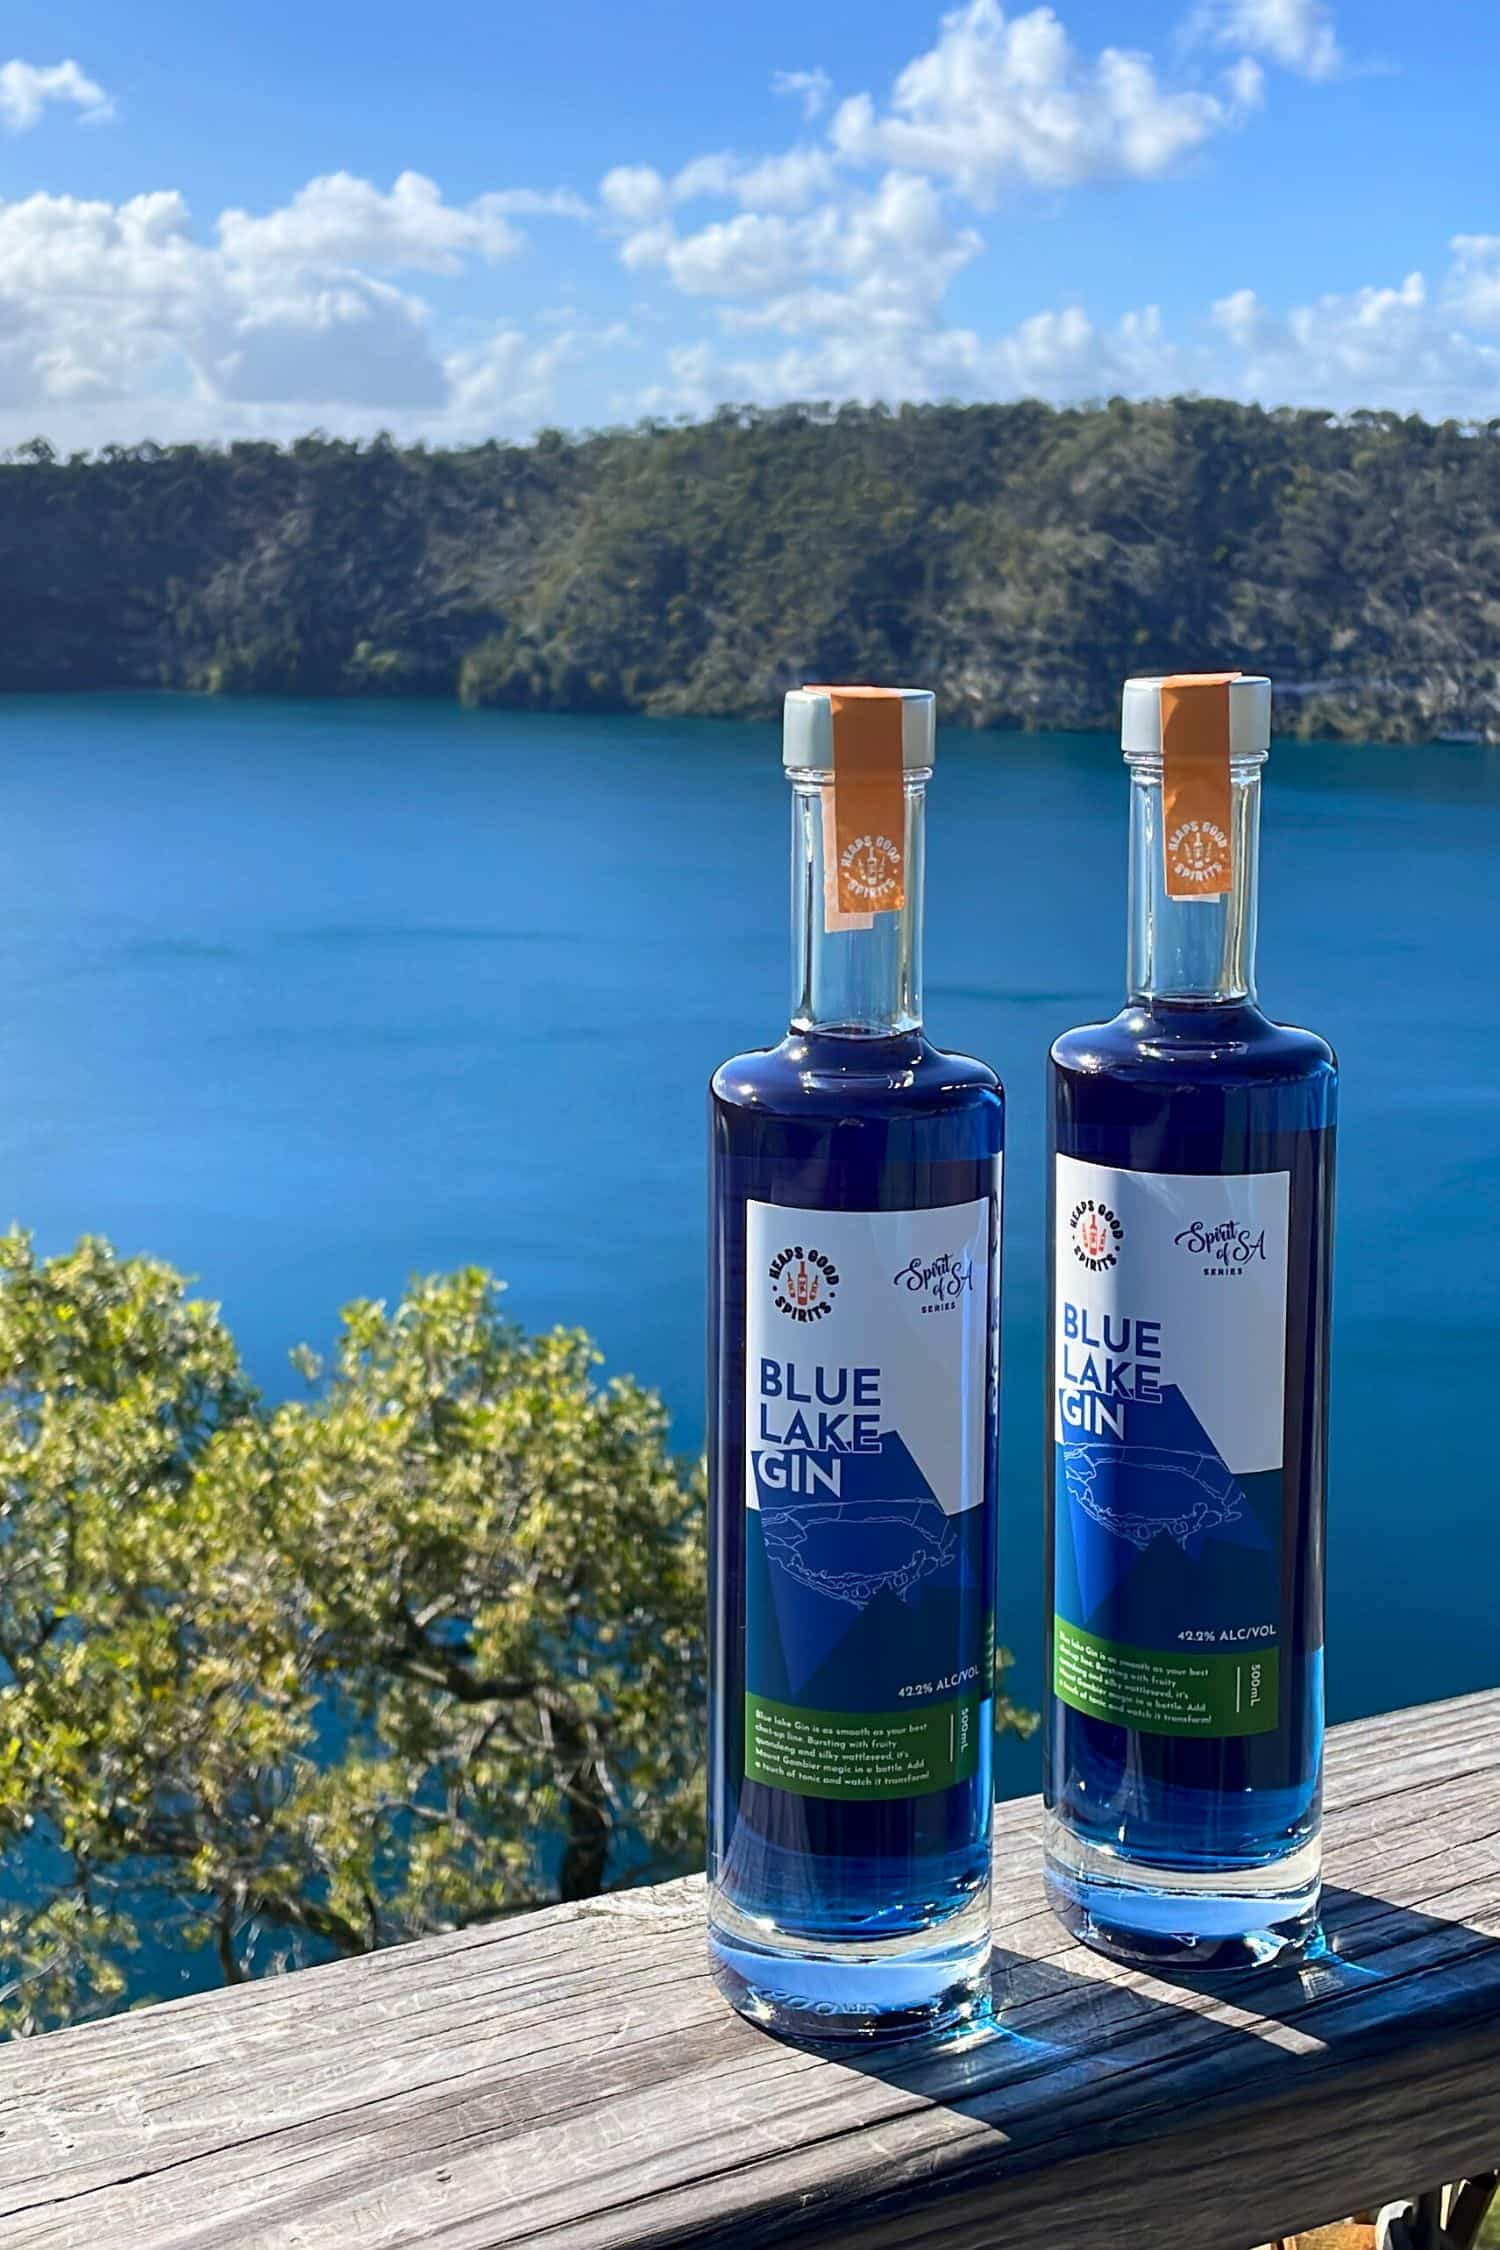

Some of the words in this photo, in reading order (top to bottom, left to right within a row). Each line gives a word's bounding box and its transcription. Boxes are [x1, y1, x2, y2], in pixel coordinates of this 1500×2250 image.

[1070, 1200, 1095, 1229] HEAPS
[1098, 1204, 1124, 1240] GOOD
[1174, 1220, 1241, 1254] Spirit
[1073, 1246, 1117, 1272] SPIRITS
[1216, 1243, 1229, 1266] of
[1232, 1230, 1267, 1265] SA
[769, 1246, 804, 1281] HEAPS
[807, 1249, 840, 1286] GOOD
[894, 1252, 953, 1291] Spirit
[933, 1281, 945, 1300] of
[946, 1260, 973, 1298] SA
[1203, 1267, 1243, 1276] SERIES
[774, 1295, 832, 1323] SPIRITS
[921, 1301, 957, 1314] SERIES
[1063, 1302, 1162, 1359] BLUE
[760, 1357, 881, 1407] BLUE
[1063, 1343, 1163, 1404] LAKE
[760, 1403, 882, 1454] LAKE
[1062, 1389, 1125, 1441] GIN
[758, 1450, 842, 1498] GIN
[1177, 1629, 1216, 1642] 42.2%
[1219, 1624, 1277, 1641] ALC/VOL
[1085, 1646, 1098, 1657] Gin
[1188, 1667, 1209, 1677] best
[897, 1681, 934, 1697] 42.2%
[936, 1664, 980, 1692] ALC/VOL
[1250, 1664, 1261, 1707] 500mL
[1186, 1703, 1206, 1712] Add
[794, 1721, 809, 1732] Gin
[908, 1723, 928, 1733] best
[807, 1735, 846, 1751] Bursting
[871, 1739, 897, 1750] fruity
[960, 1707, 969, 1753] 500mL
[782, 1755, 820, 1770] Gambier
[907, 1759, 925, 1769] Add
[797, 1748, 816, 1758] and
[818, 1750, 839, 1762] silky
[786, 1769, 796, 1778] of
[823, 1776, 842, 1785] and
[844, 1776, 872, 1787] watch
